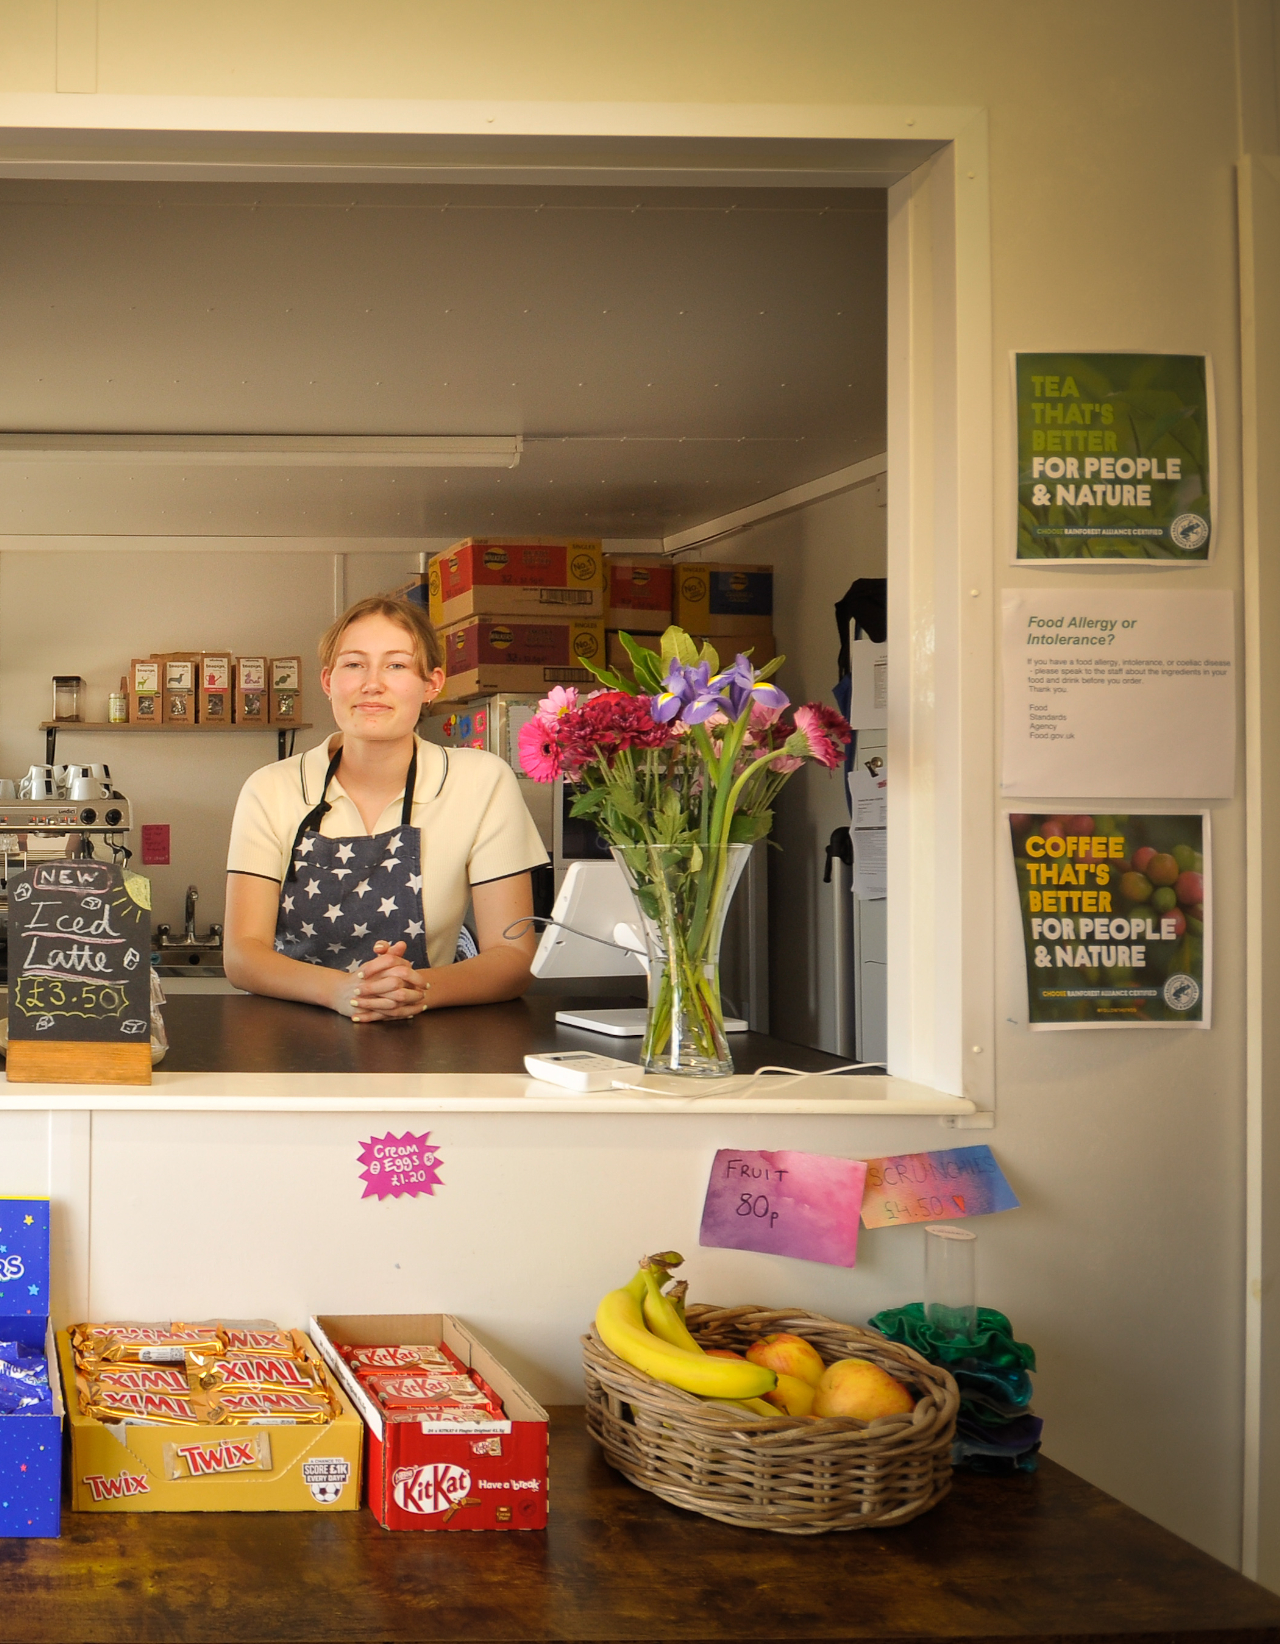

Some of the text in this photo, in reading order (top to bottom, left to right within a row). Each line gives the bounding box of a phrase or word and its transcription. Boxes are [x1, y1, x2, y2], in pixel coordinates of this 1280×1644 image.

[1031, 375, 1080, 398] TEA
[1031, 402, 1114, 425] THAT'S
[1032, 430, 1118, 452] BETTER
[1032, 457, 1182, 480] FOR PEOPLE
[1031, 483, 1152, 507] & NATURE
[1027, 616, 1138, 632] Food Allergy or
[1026, 633, 1116, 646] Intolerance?
[1029, 713, 1068, 721] Standards
[1029, 723, 1058, 731] Agency
[1024, 835, 1125, 859] COFFEE
[40, 869, 99, 884] NEW
[1026, 863, 1111, 886] THAT'S
[1029, 890, 1113, 913] BETTER
[24, 901, 121, 937] Iced
[1031, 917, 1177, 941] FOR PEOPLE
[22, 936, 114, 973] Latte
[1034, 945, 1147, 968] & NATURE
[25, 979, 120, 1010] £3.50
[373, 1143, 420, 1159] Cream
[382, 1154, 421, 1173] Eggs
[725, 1158, 789, 1183] FRUIT
[869, 1155, 998, 1188] SCRUNCHIES
[390, 1169, 427, 1187] £1.20
[735, 1192, 780, 1229] 80p
[883, 1194, 946, 1221] £4.50
[363, 1346, 417, 1368] KitKat
[392, 1376, 446, 1399] KitKat
[303, 1464, 329, 1475] SCORE
[306, 1475, 327, 1483] EVERY
[402, 1464, 468, 1513] KitKat
[477, 1479, 503, 1490] Have
